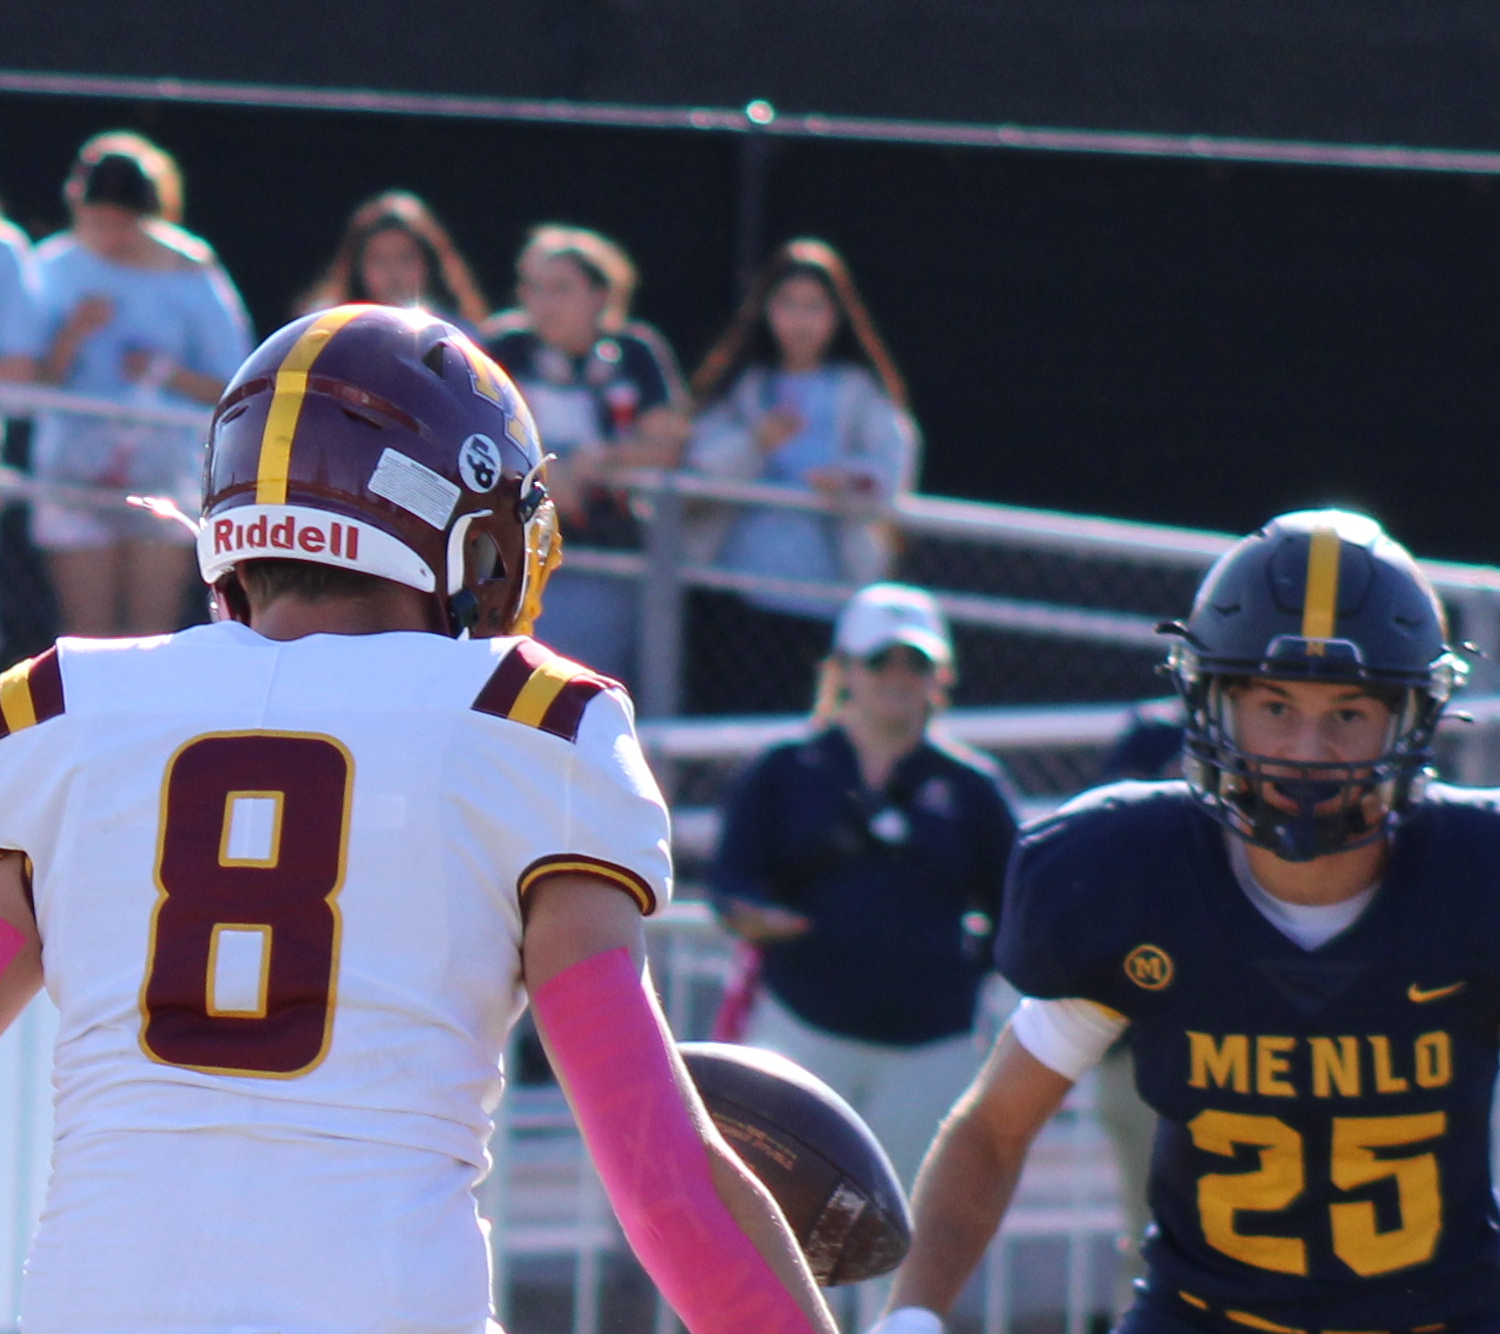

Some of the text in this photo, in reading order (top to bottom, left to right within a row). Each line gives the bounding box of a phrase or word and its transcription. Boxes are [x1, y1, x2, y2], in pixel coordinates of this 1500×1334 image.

[212, 513, 360, 561] Riddell
[137, 728, 356, 1080] 8
[1185, 1029, 1454, 1099] MENLO
[1186, 1108, 1448, 1278] 25
